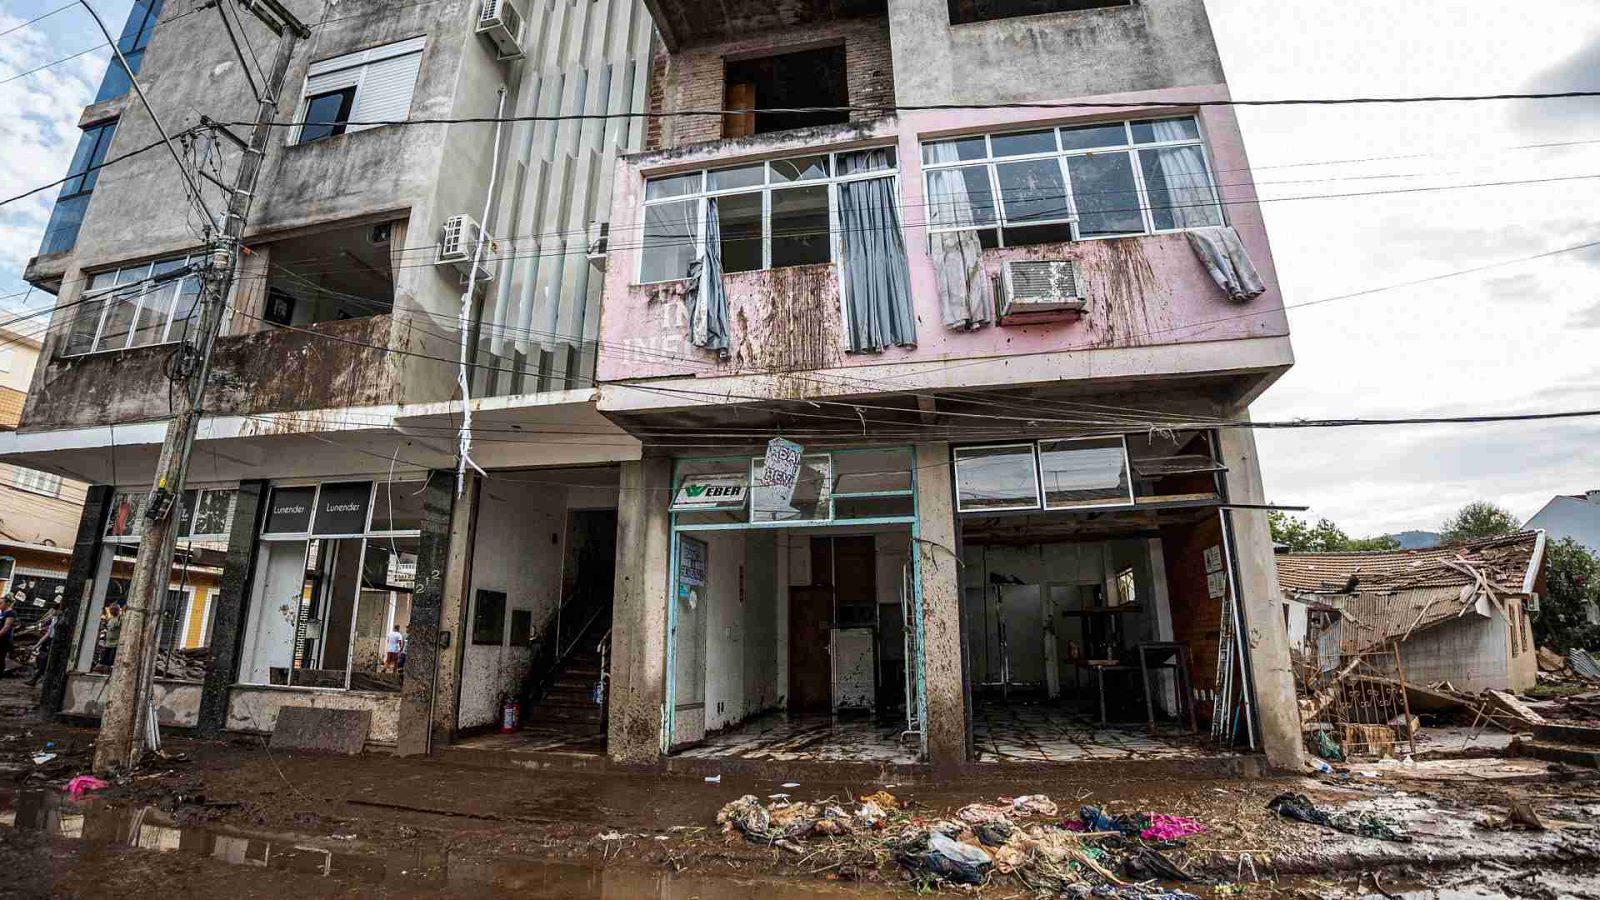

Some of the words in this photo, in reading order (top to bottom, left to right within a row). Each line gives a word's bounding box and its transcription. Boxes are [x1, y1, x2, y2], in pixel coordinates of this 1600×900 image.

[684, 484, 741, 498] WEBER
[273, 505, 305, 514] Lunender
[326, 502, 360, 512] Lunender
